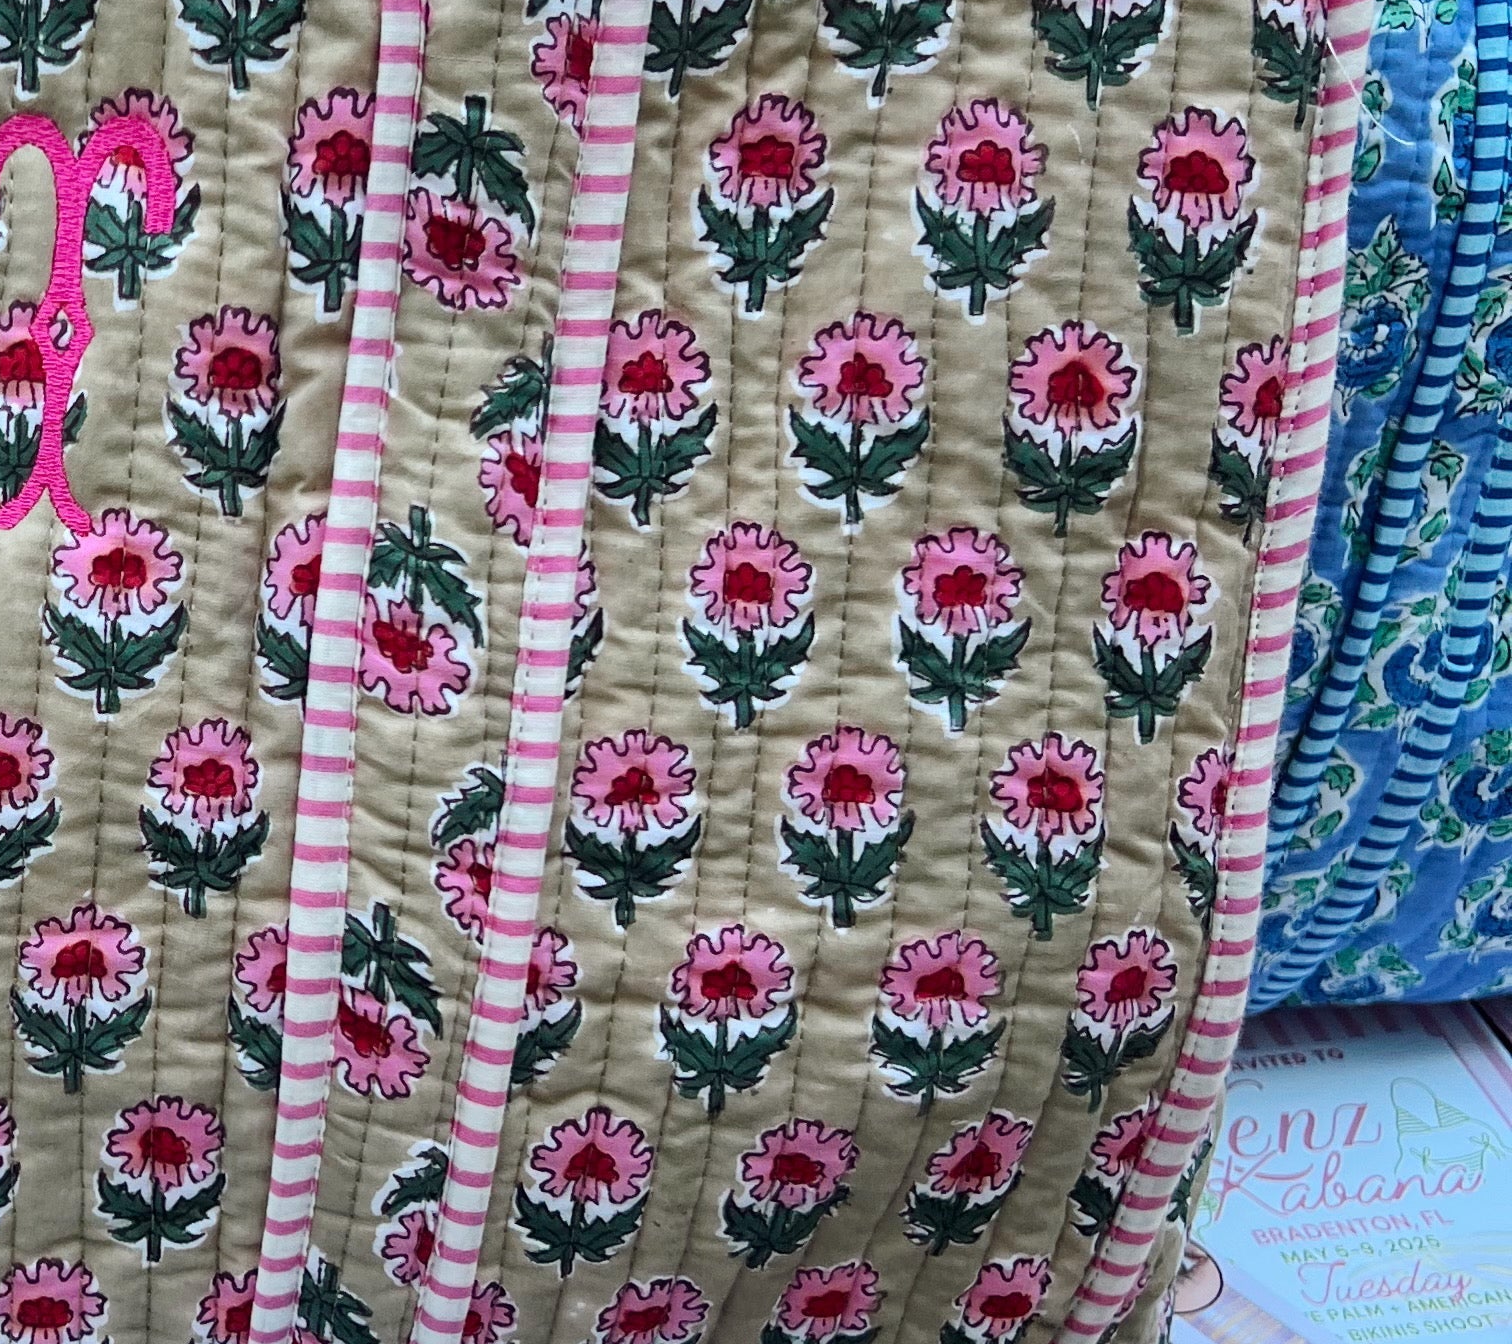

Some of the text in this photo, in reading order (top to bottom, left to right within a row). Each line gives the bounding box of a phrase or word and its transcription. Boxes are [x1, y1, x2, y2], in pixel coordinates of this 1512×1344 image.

[1207, 1149, 1484, 1222] Kabana
[1250, 1208, 1455, 1247] BRADENTON, FL
[1297, 1258, 1473, 1307] Tuesday
[1407, 1288, 1512, 1313] AMERICAN
[1347, 1314, 1494, 1342] BIKINIS SHOOT
